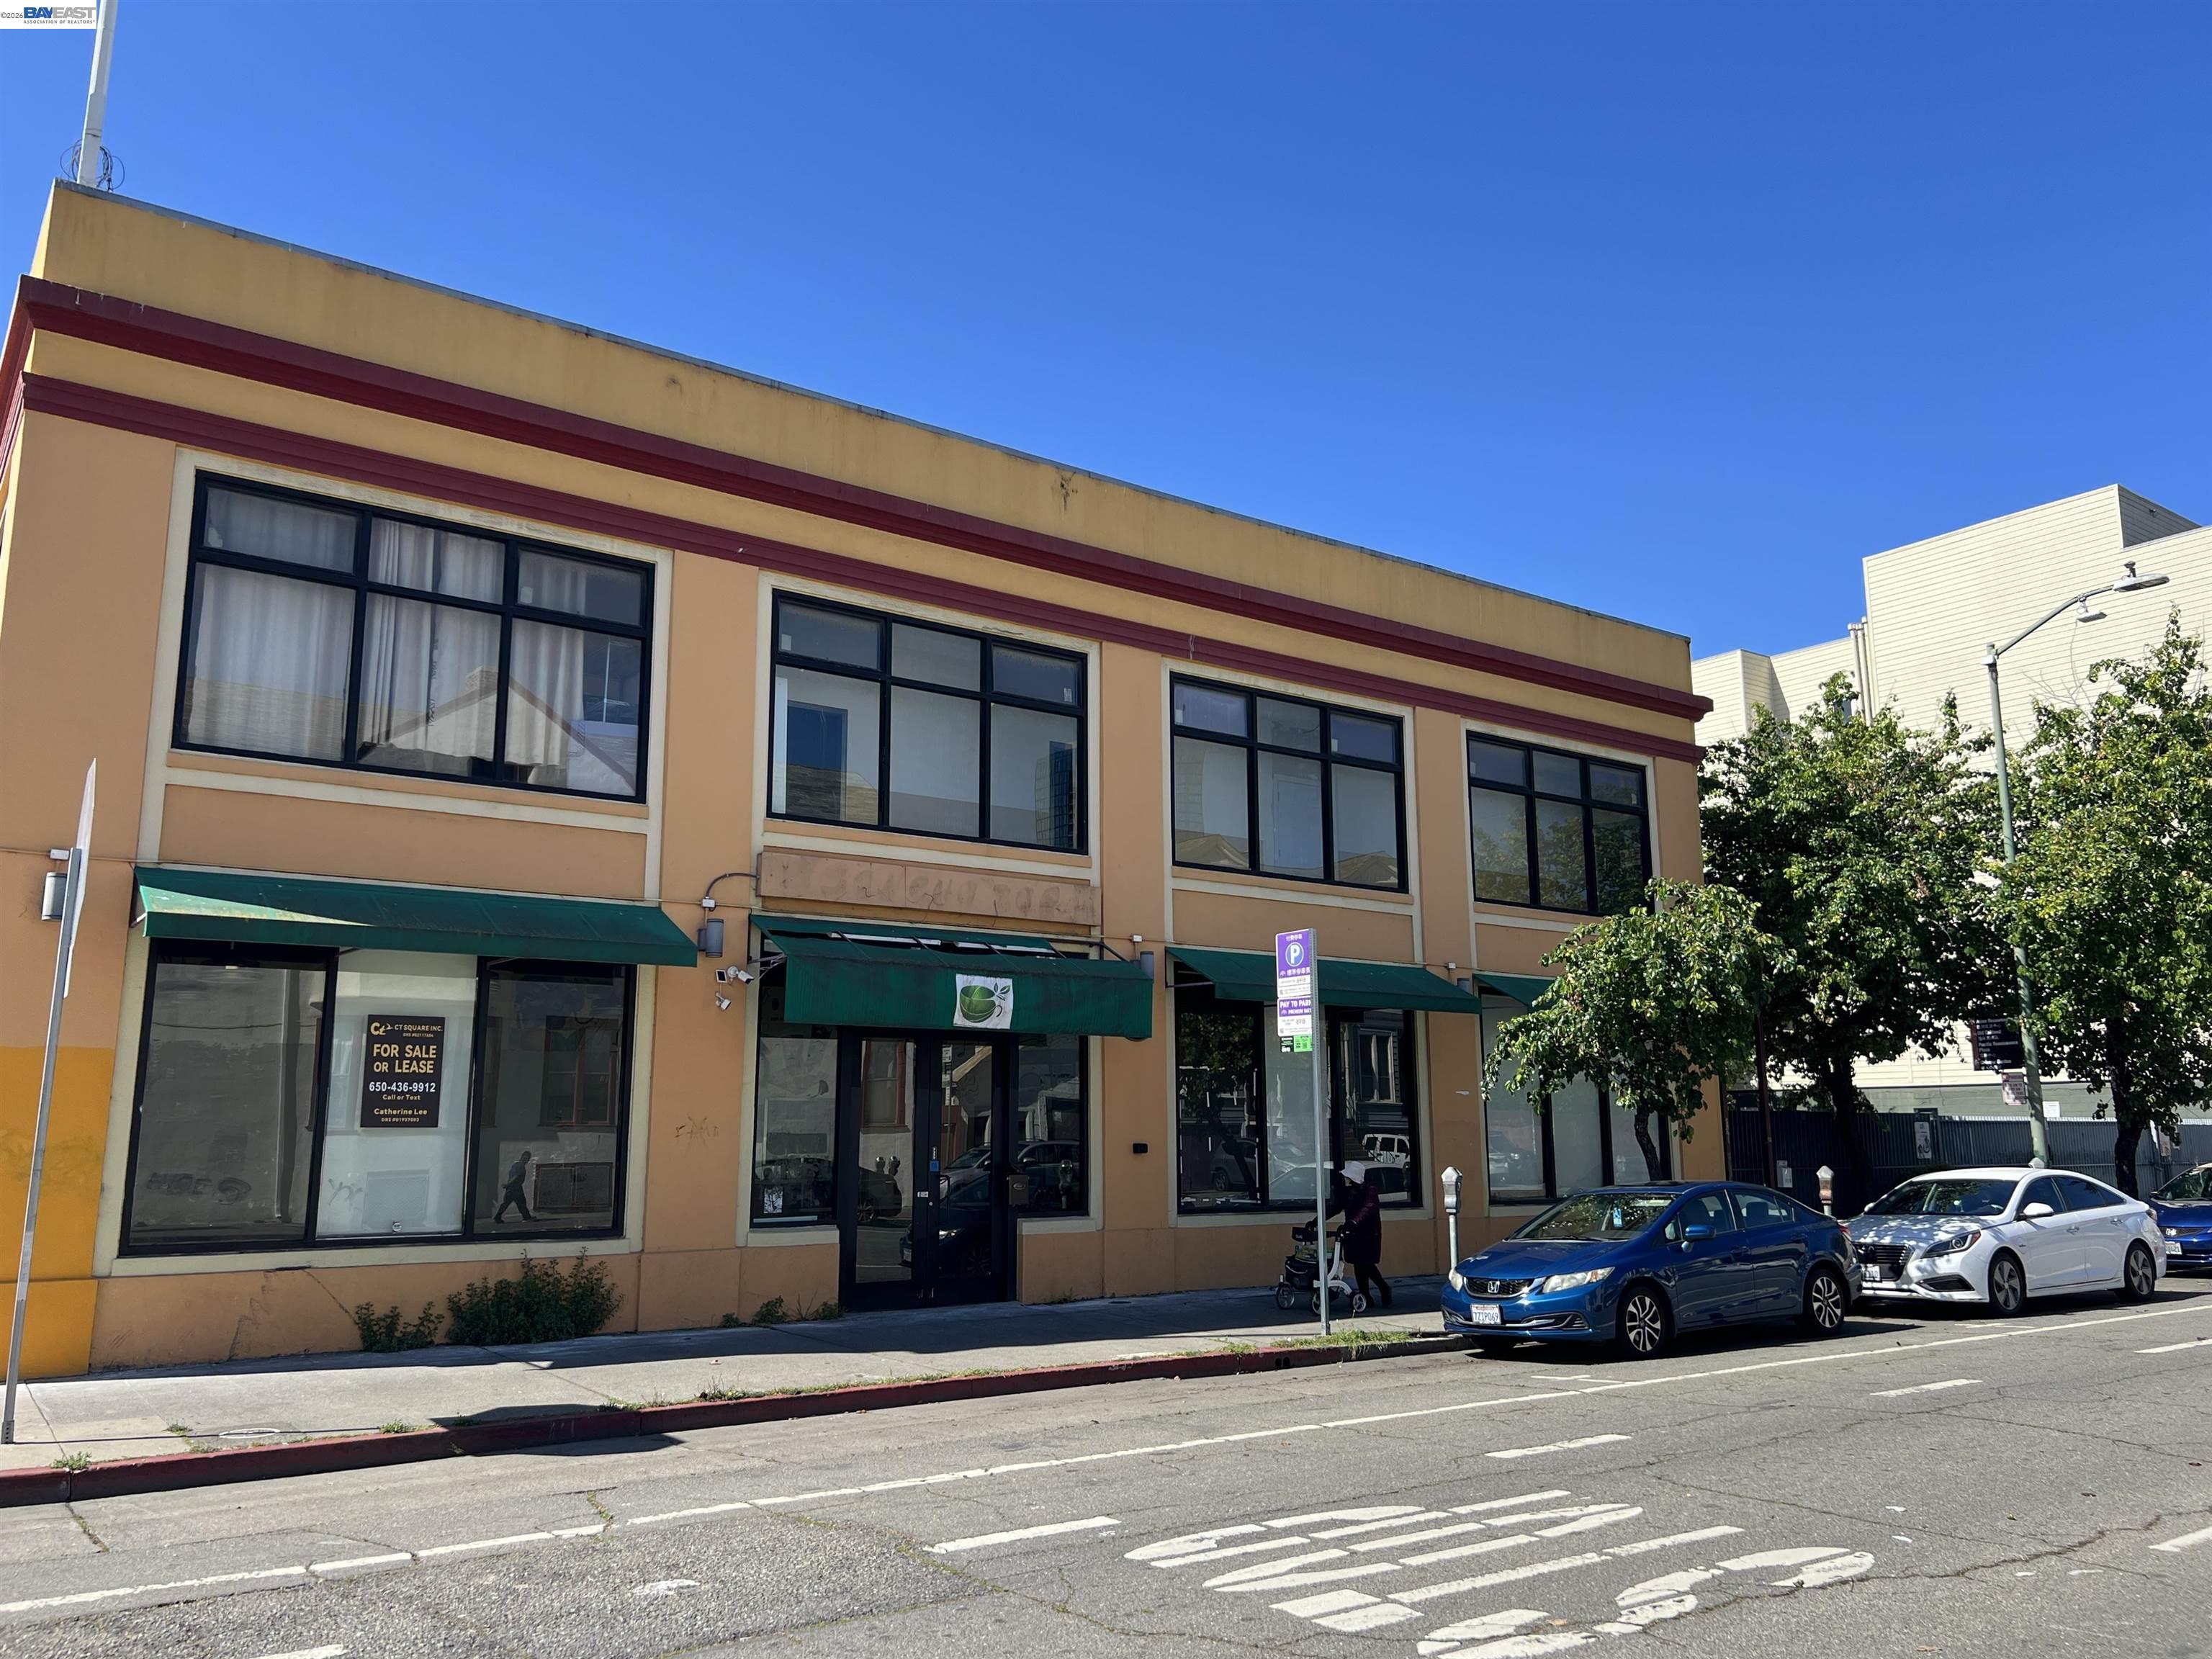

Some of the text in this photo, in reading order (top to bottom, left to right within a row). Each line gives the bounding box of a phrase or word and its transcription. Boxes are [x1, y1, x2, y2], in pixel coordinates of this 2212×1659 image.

[1290, 945, 1300, 964] P
[373, 1044, 436, 1058] FOR SALE
[374, 1060, 434, 1074] OR LEASE
[369, 1082, 436, 1092] 650-436-9912
[1473, 1312, 1498, 1321] 7ZIP069
